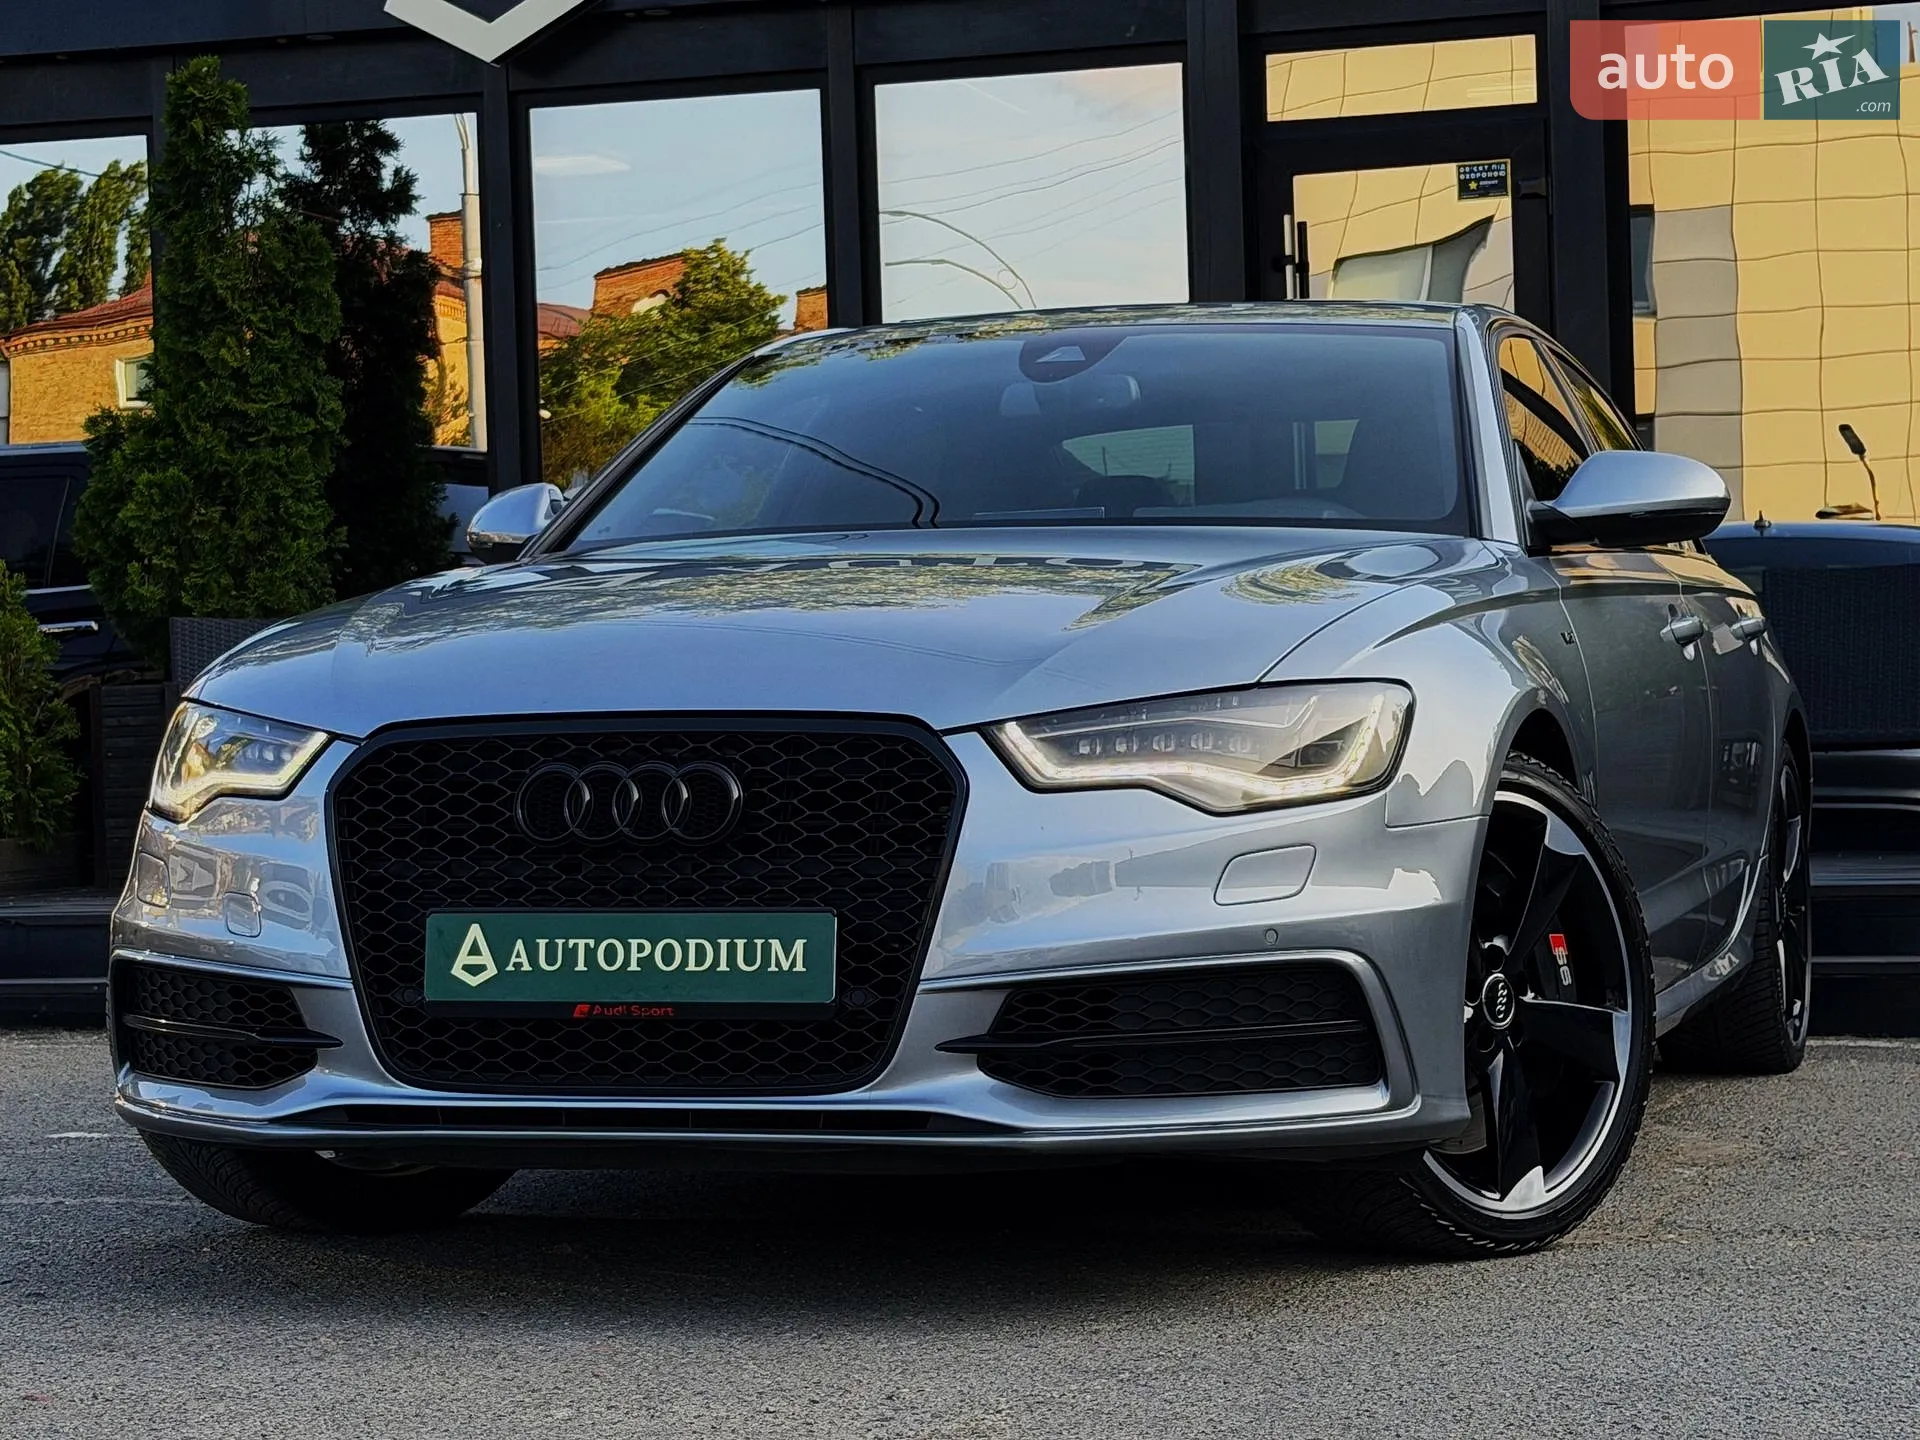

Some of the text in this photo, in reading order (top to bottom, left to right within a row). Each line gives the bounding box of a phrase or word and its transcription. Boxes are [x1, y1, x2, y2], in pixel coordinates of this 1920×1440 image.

[505, 938, 807, 972] AUTOPODIUM
[593, 1004, 674, 1017] Audi Sport
